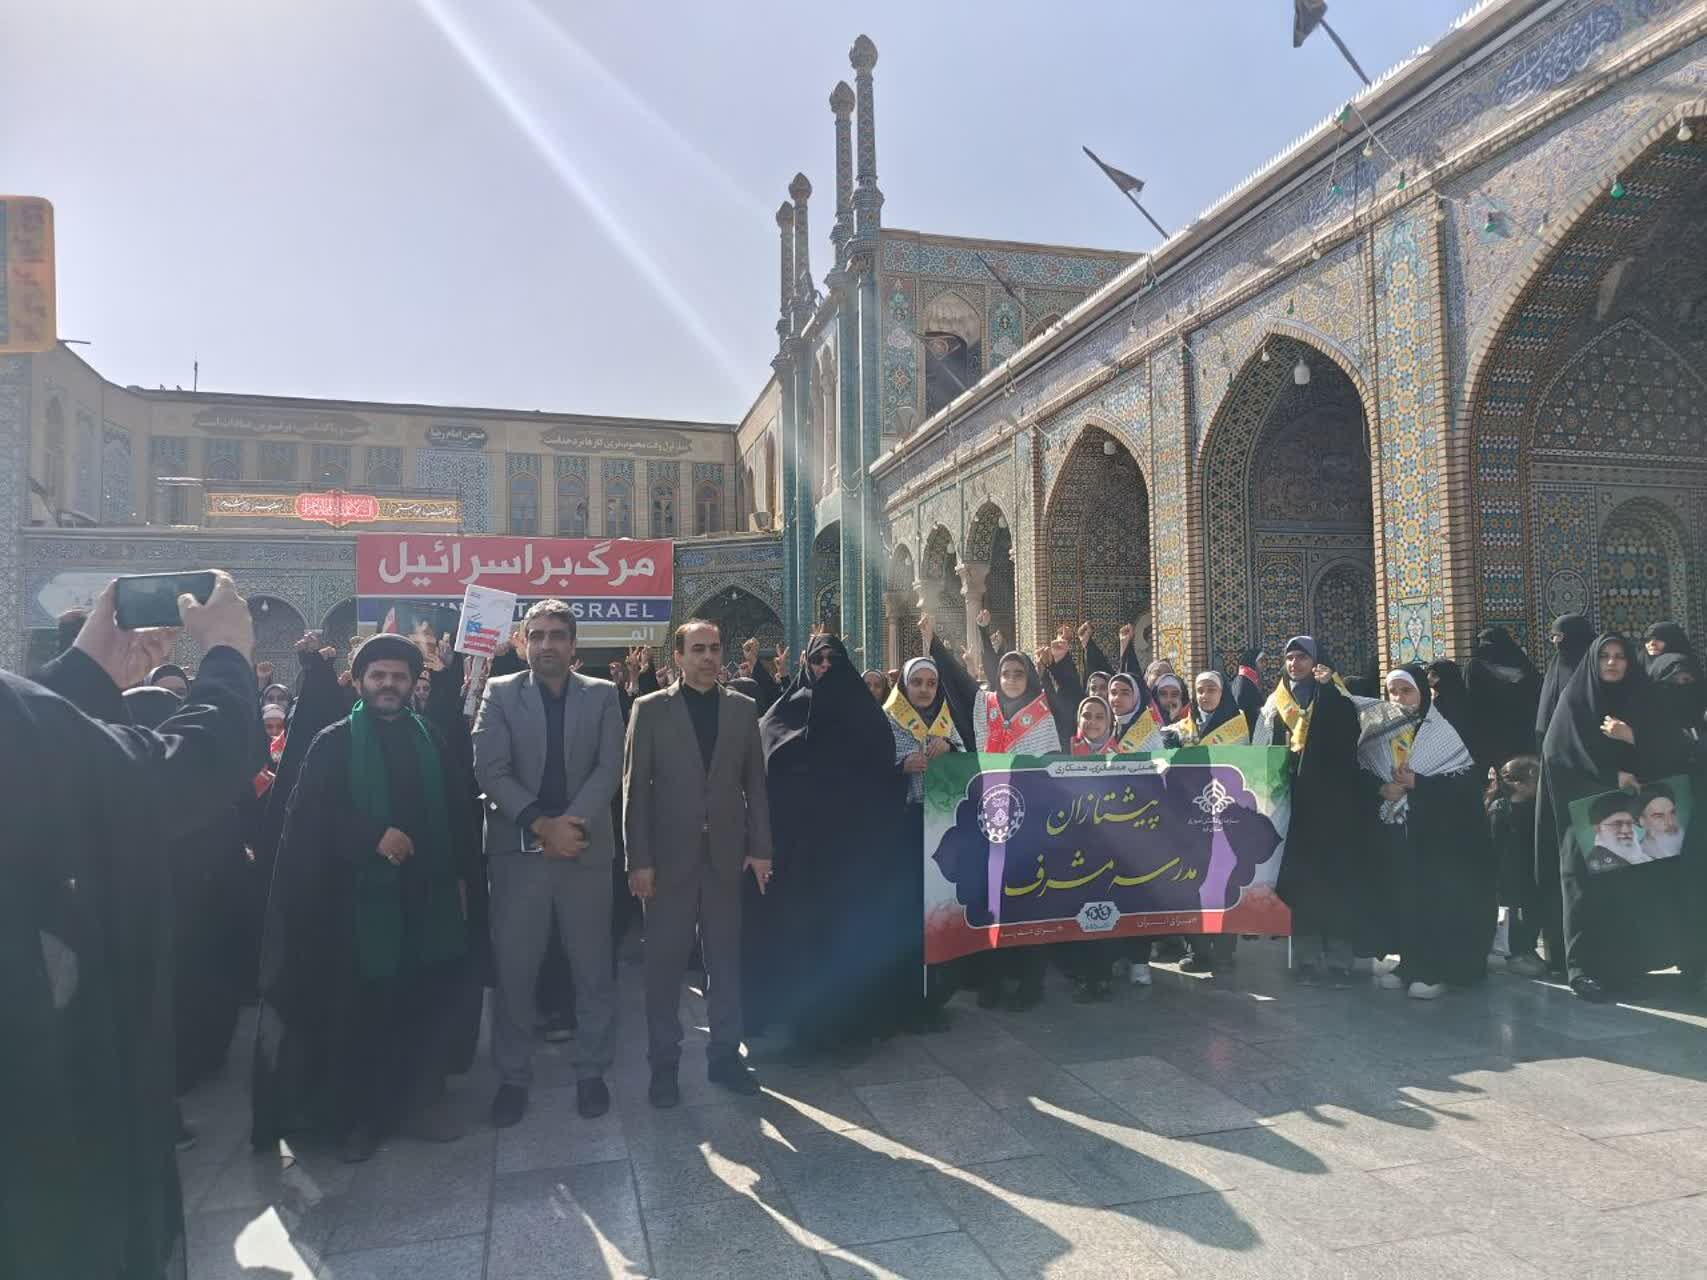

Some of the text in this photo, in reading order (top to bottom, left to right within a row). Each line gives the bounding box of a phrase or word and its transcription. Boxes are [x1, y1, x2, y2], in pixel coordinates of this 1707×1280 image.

[378, 540, 533, 587] اسرائیل
[530, 555, 573, 588] بر
[574, 539, 655, 587] مرگ
[570, 603, 655, 619] SRAEL
[1046, 785, 1161, 836] پیشتازان
[1104, 856, 1198, 897] مدرسه
